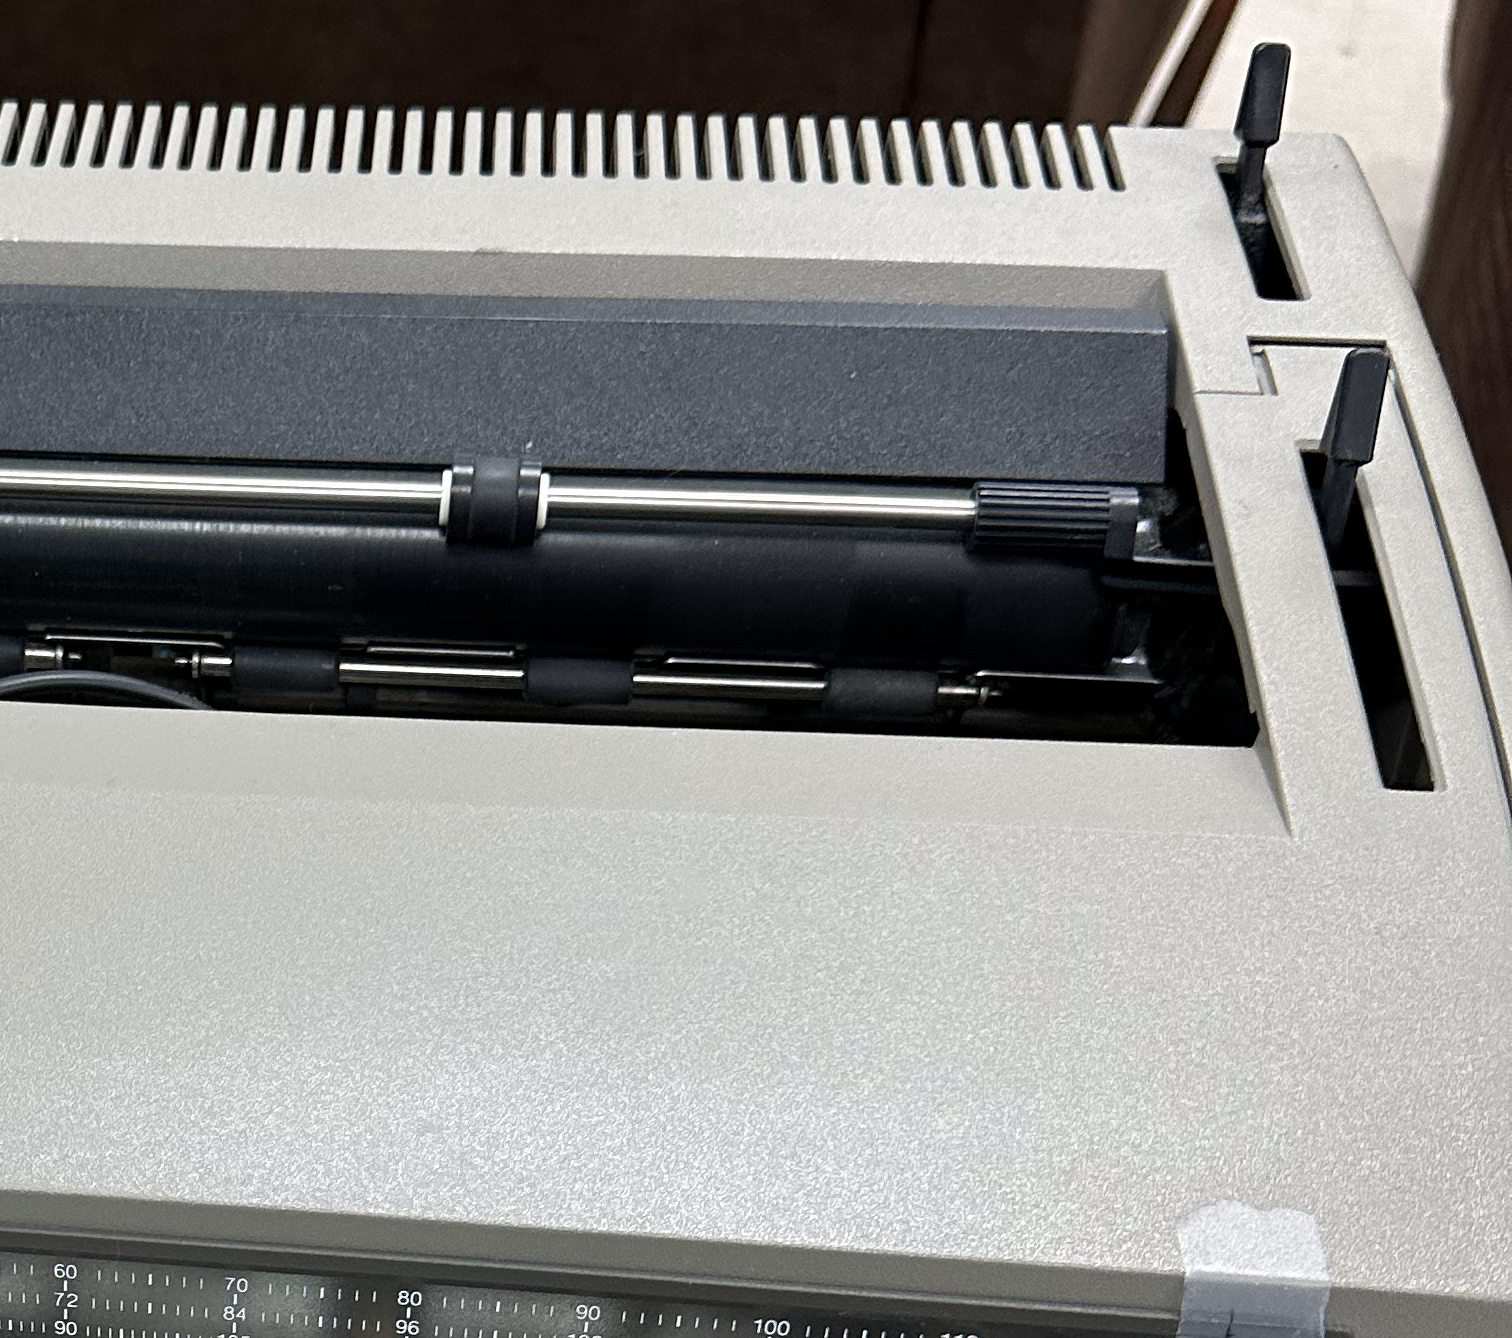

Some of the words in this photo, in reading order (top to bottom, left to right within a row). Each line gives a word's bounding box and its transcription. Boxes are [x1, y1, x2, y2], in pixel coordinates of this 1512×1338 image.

[53, 1264, 78, 1279] 60
[225, 1277, 249, 1293] 70
[397, 1291, 423, 1306] 80
[575, 1305, 601, 1321] 90
[753, 1320, 790, 1337] 100
[53, 1292, 79, 1308] 72
[222, 1306, 246, 1322] 84
[395, 1320, 420, 1335] 96
[53, 1321, 78, 1336] 90
